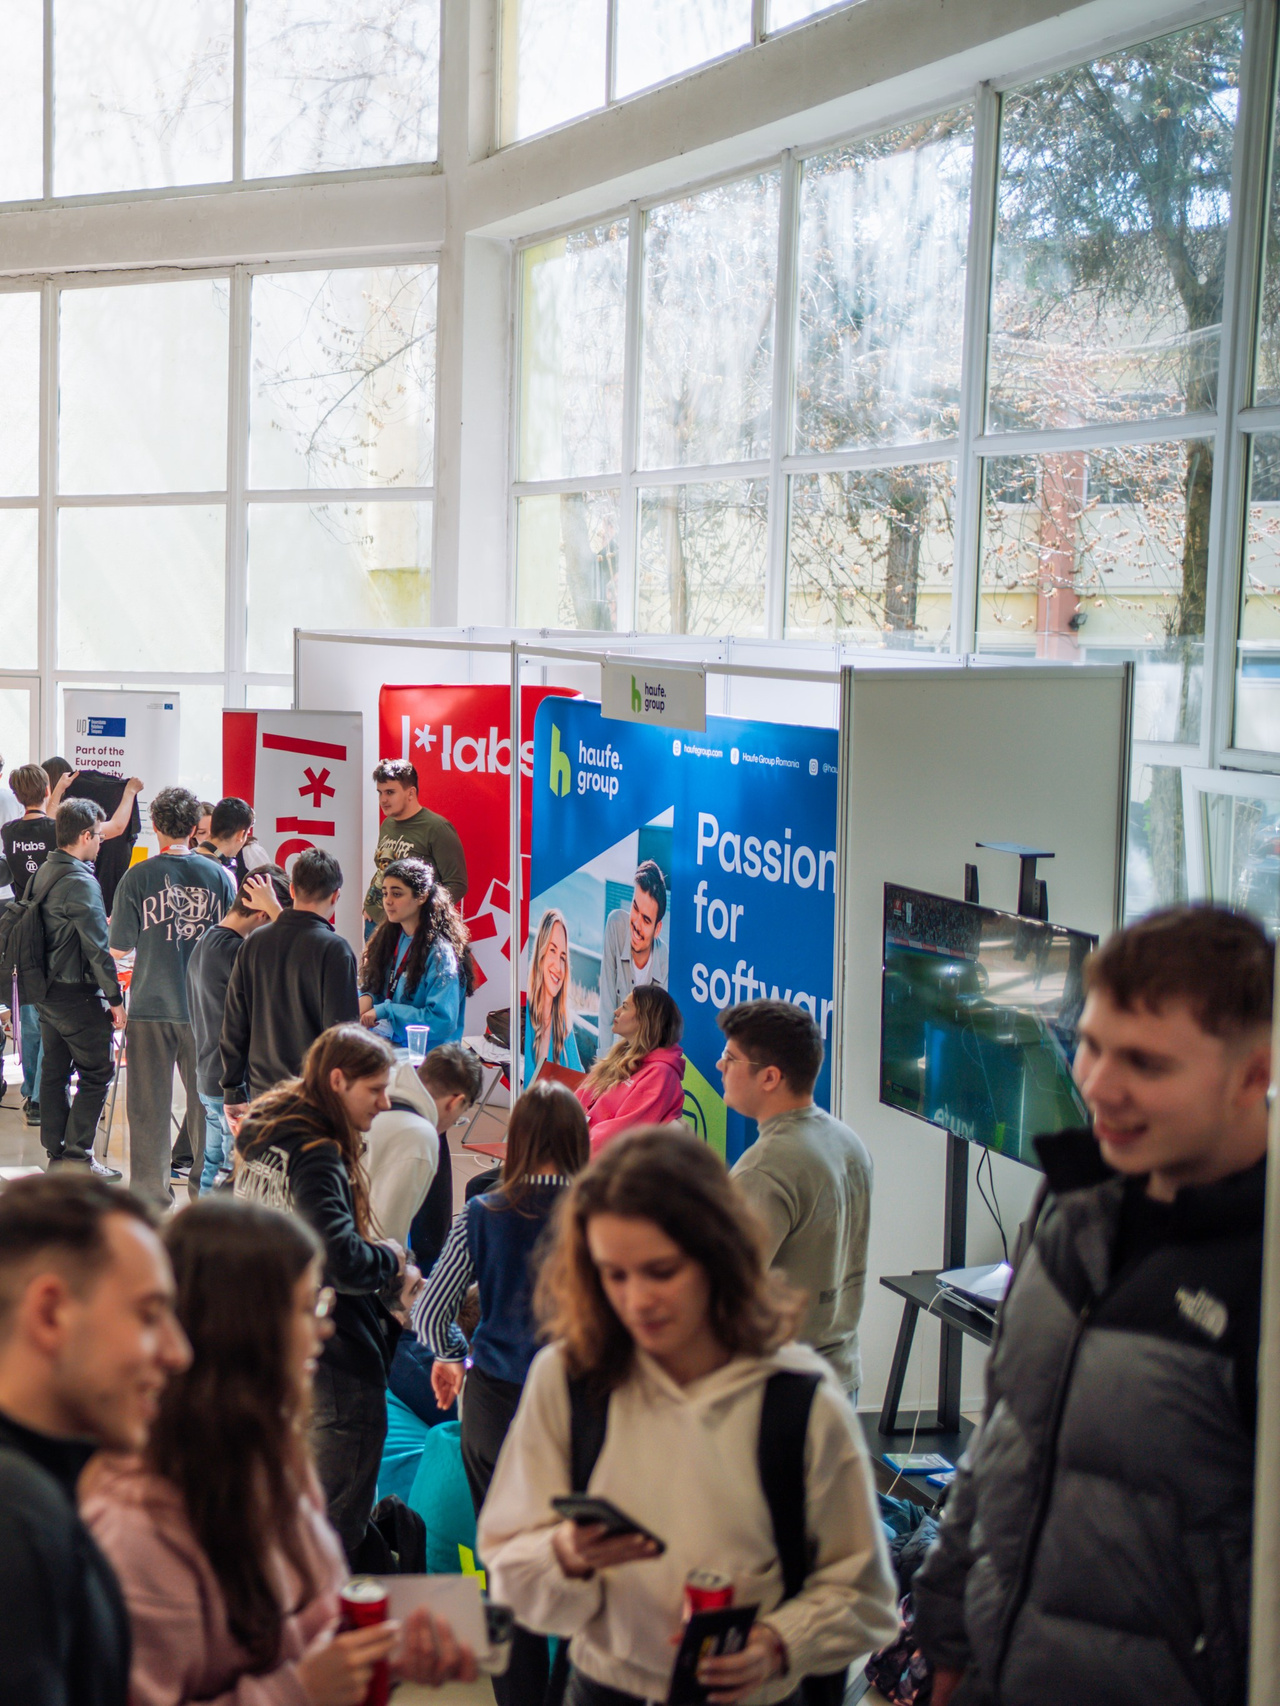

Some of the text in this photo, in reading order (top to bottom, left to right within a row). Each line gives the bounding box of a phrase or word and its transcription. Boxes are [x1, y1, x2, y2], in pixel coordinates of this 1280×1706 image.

[644, 698, 666, 713] group
[75, 746, 125, 756] Part of the
[75, 757, 121, 769] European
[742, 752, 800, 769] Haufe Group Romania
[822, 763, 838, 774] @hau
[577, 771, 619, 800] group
[697, 811, 837, 893] Passion
[693, 880, 744, 943] for
